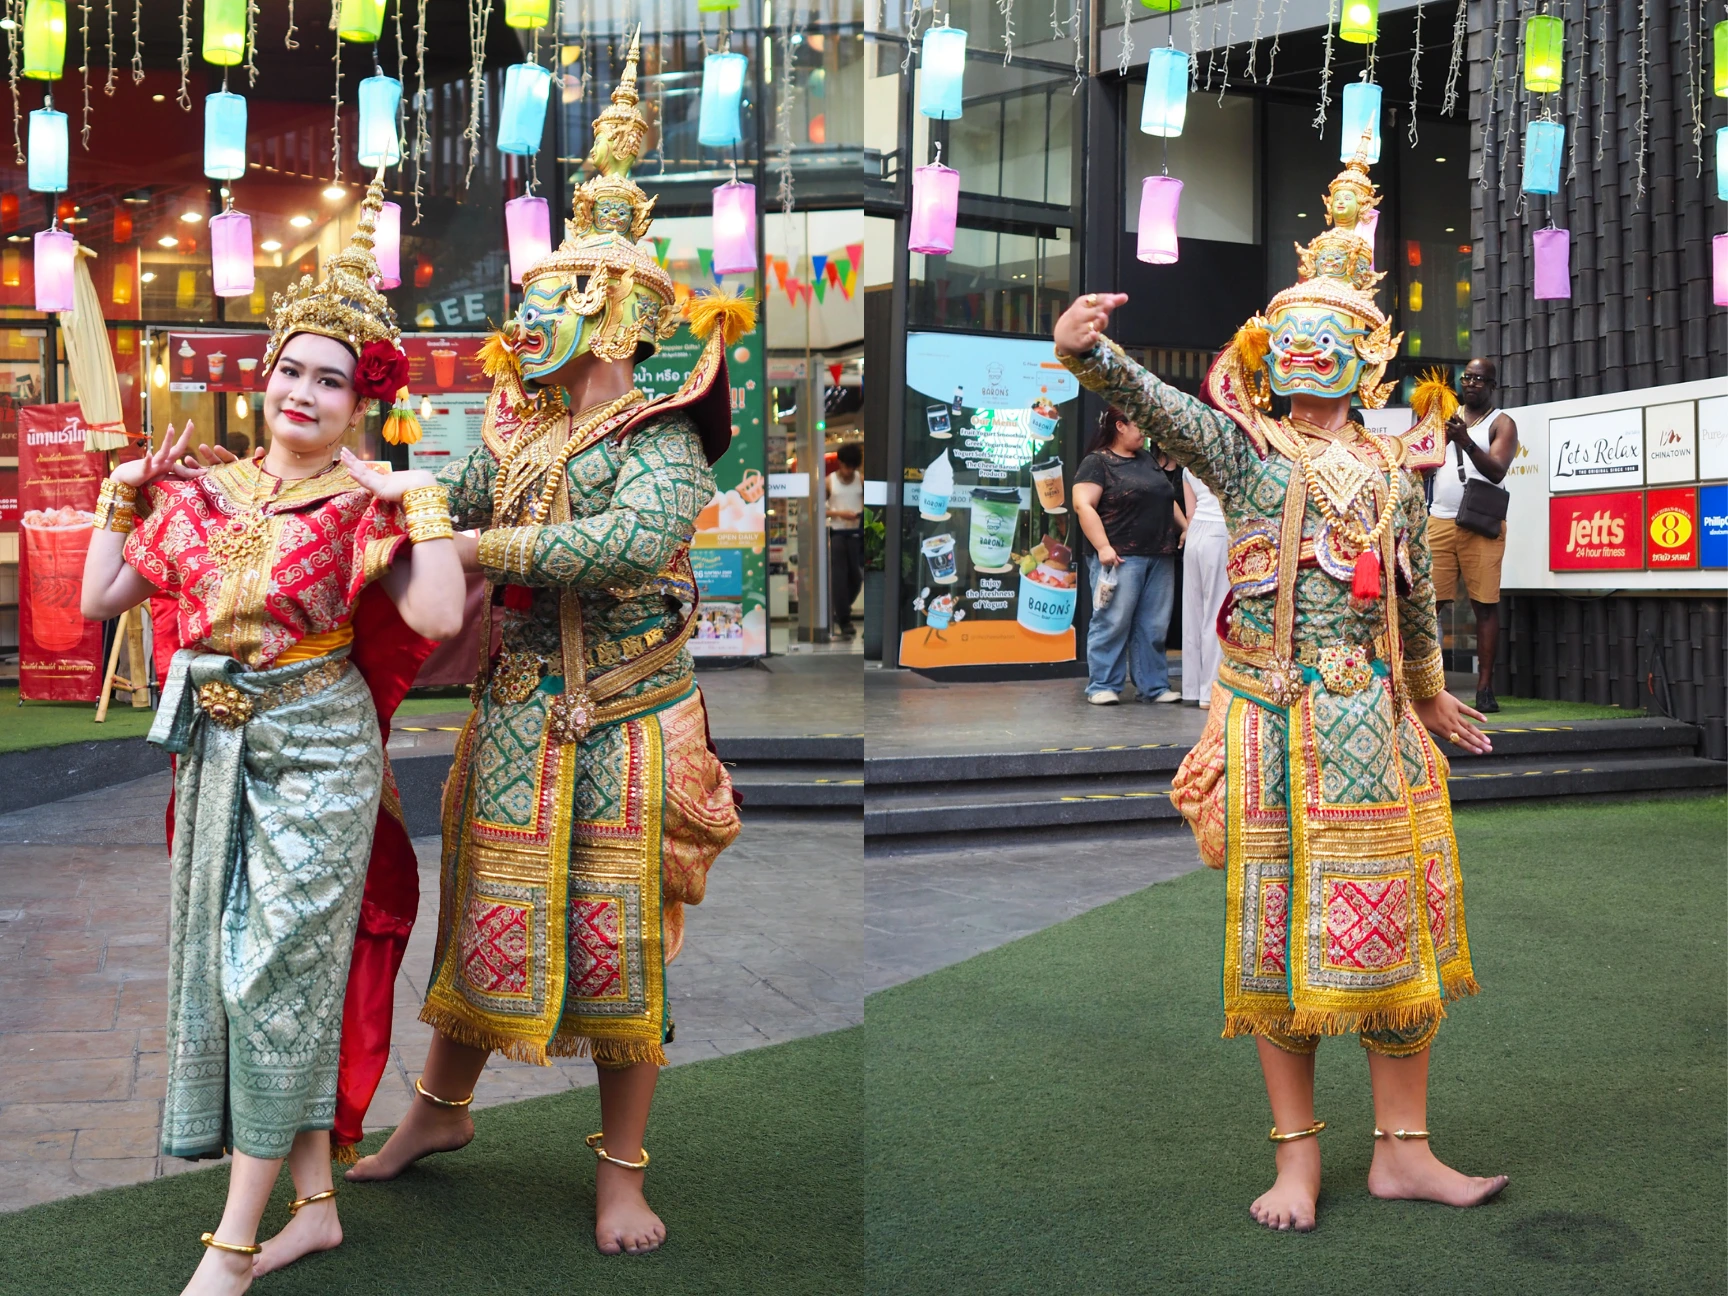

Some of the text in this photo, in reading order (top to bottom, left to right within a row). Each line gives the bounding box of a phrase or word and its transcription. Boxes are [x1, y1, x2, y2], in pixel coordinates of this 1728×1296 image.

[981, 386, 1009, 396] BARON'S
[971, 415, 1017, 428] Our Menu
[27, 417, 86, 446] นิทานชาไท
[960, 428, 1027, 439] Fruit Yogurt Smoothies
[965, 439, 983, 447] Greek
[985, 441, 1004, 450] Yogurt
[1594, 435, 1640, 465] Relax
[953, 449, 974, 458] Yogurt
[1651, 448, 1691, 460] CHINATOWN
[965, 460, 977, 468] The
[977, 461, 999, 470] Cheese
[1506, 464, 1539, 477] NATOWN
[979, 470, 1006, 478] Products
[1566, 509, 1625, 553] jetts
[1575, 546, 1626, 557] 24 hour fitness
[981, 579, 1001, 589] Enjoy
[966, 589, 1015, 598] the Freshness
[973, 600, 1008, 610] of Yogurt
[1028, 597, 1071, 615] BARON'S
